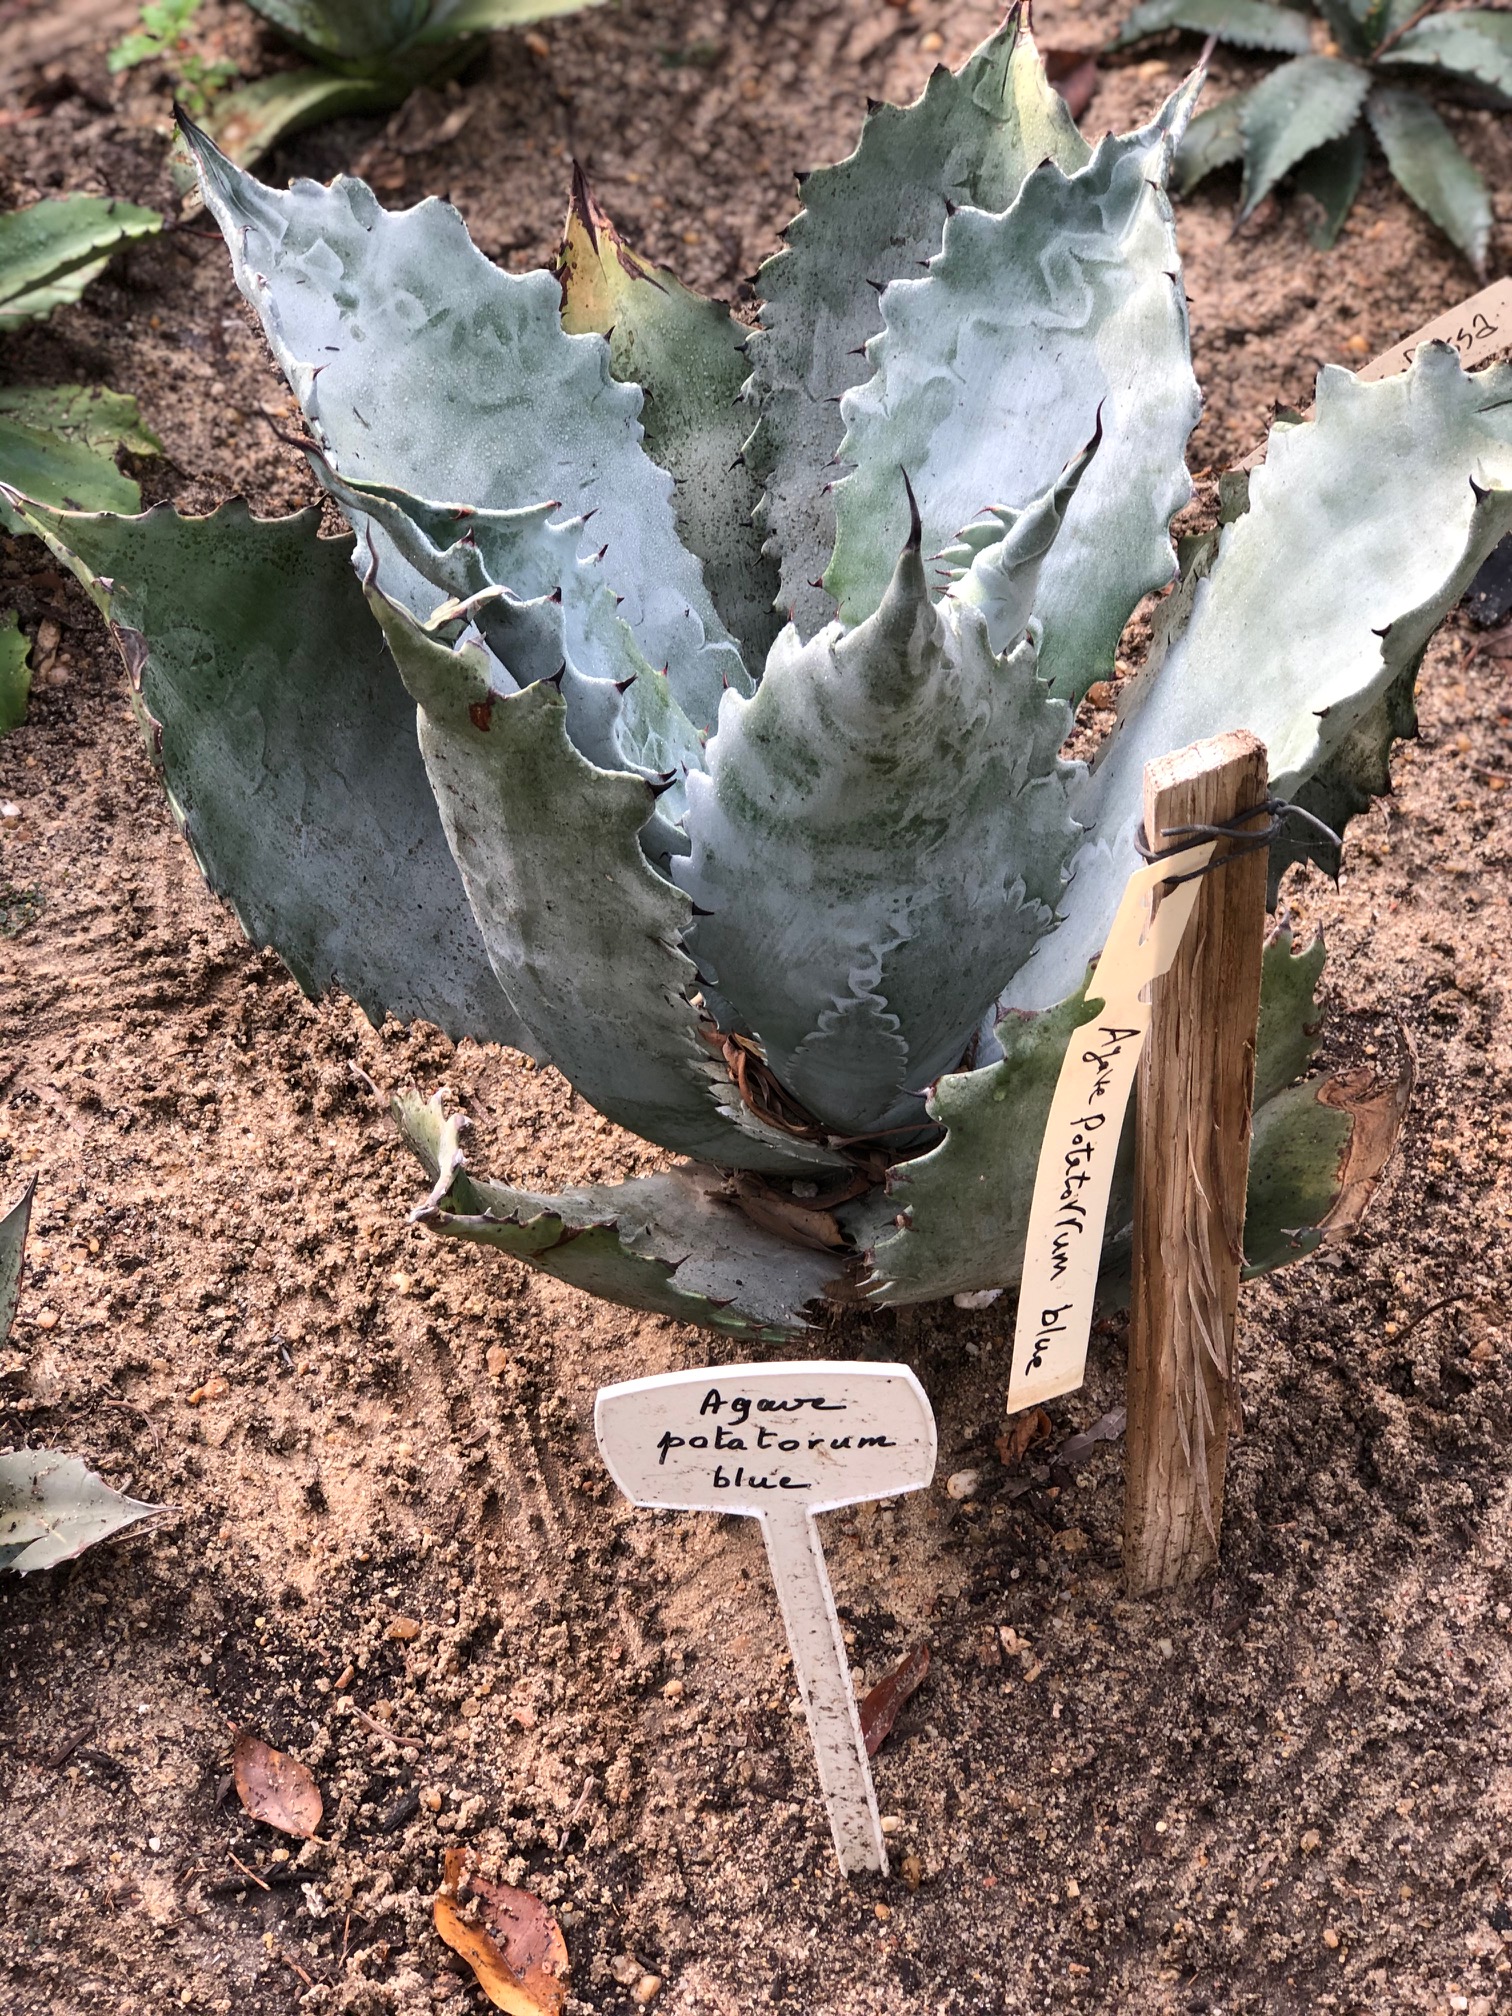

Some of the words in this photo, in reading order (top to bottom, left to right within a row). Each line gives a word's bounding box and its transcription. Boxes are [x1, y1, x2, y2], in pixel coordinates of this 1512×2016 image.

[1082, 1027, 1141, 1105] Agave
[1025, 1304, 1073, 1377] blue
[699, 1388, 847, 1425] Agave
[657, 1425, 896, 1465] potatorum
[712, 1465, 812, 1489] blue
